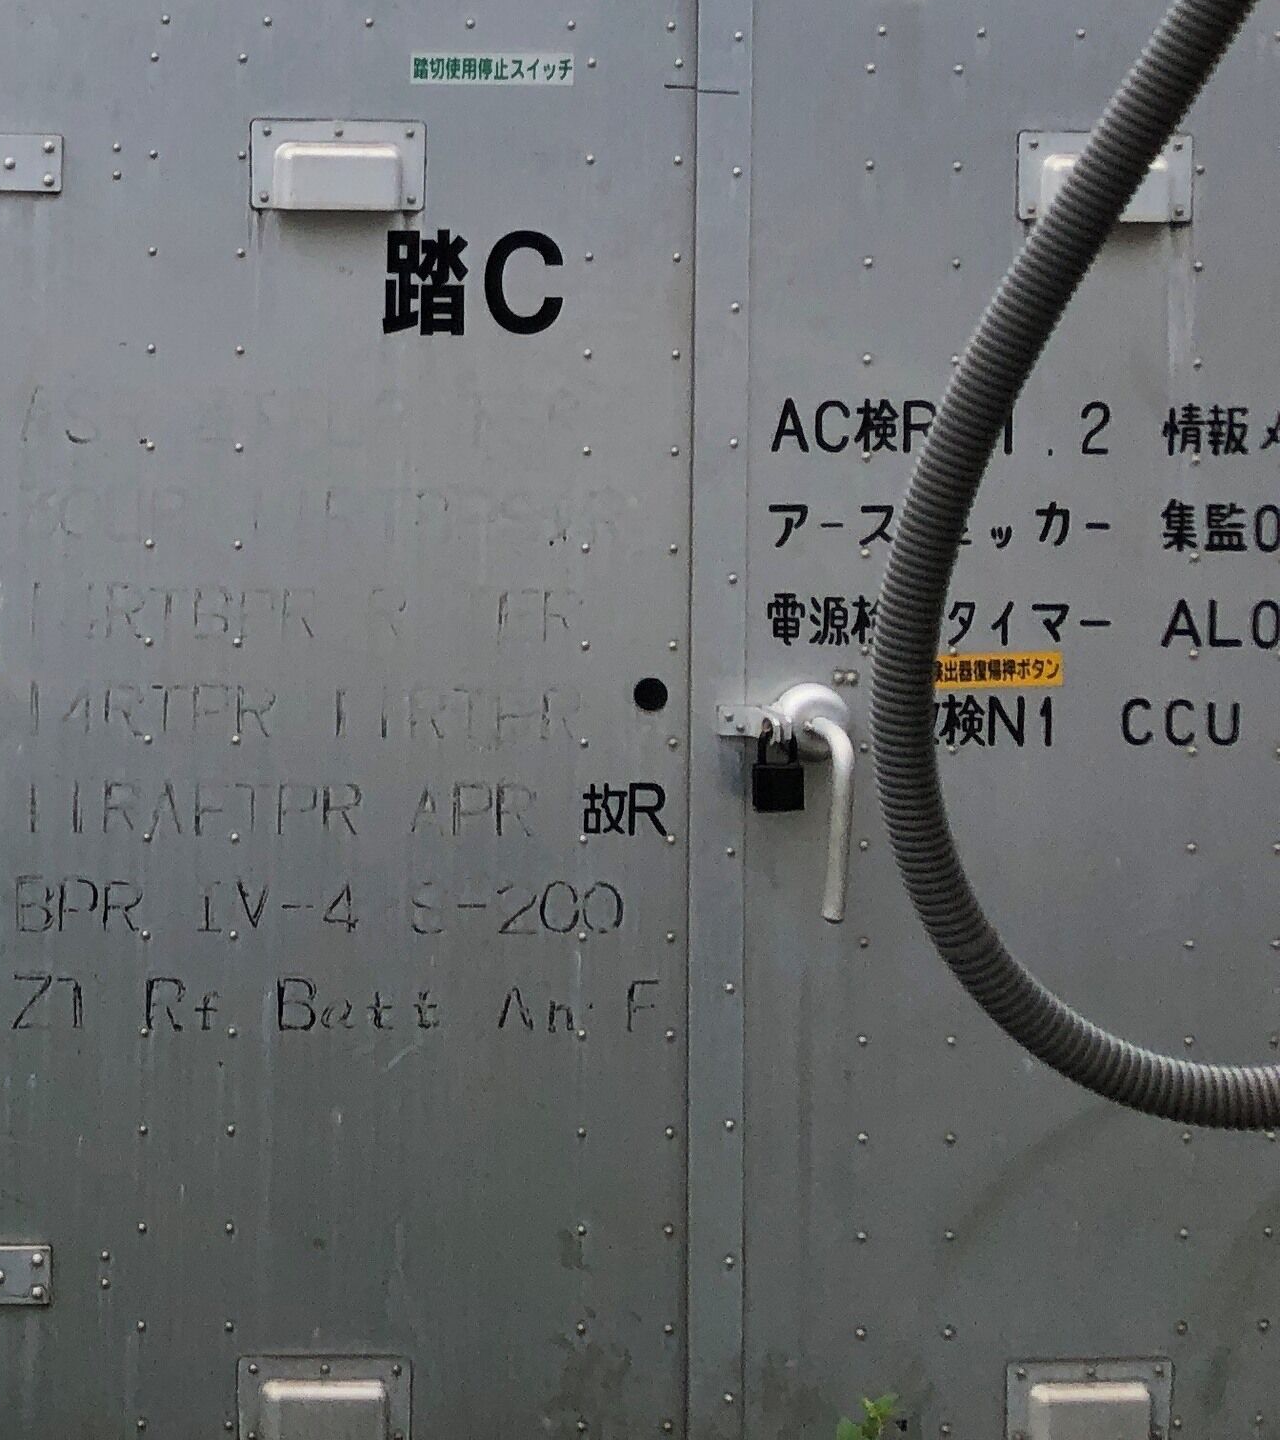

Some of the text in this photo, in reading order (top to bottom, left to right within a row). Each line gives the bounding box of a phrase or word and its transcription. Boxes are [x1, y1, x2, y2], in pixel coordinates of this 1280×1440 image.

[413, 57, 573, 81] 踏切使用停止スイッチ
[1121, 697, 1241, 747] CCU
[583, 782, 667, 837] 故R
